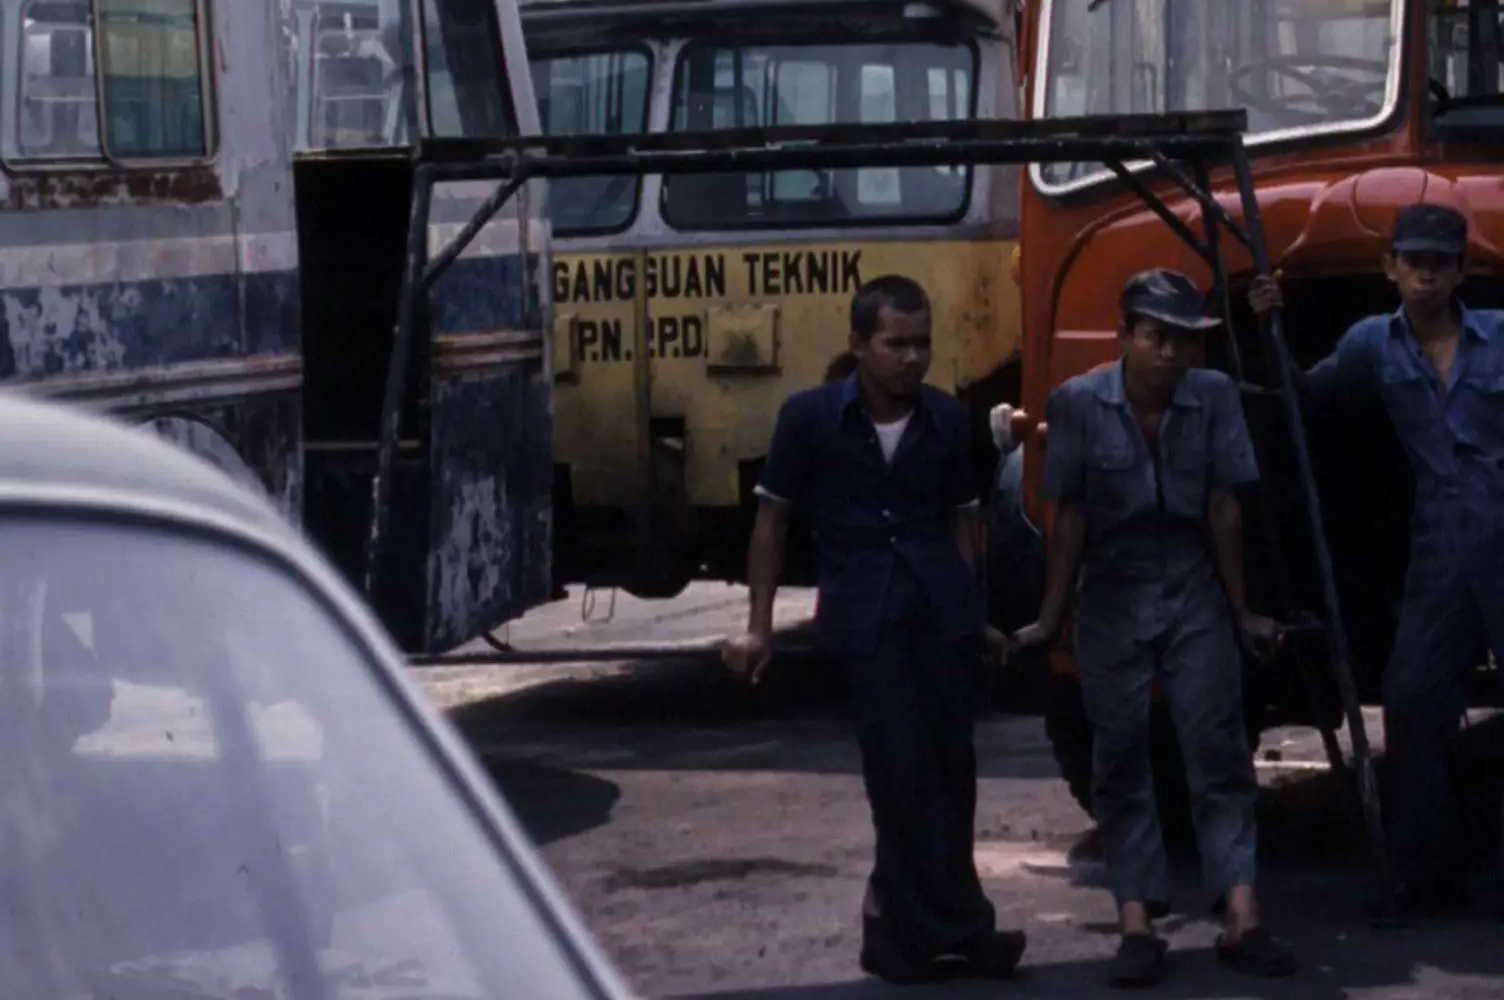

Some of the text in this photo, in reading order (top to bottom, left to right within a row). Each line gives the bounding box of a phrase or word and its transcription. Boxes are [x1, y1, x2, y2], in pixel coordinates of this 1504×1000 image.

[552, 249, 864, 303] GANGGUAN TEKNIK
[578, 317, 633, 363] P.N.
